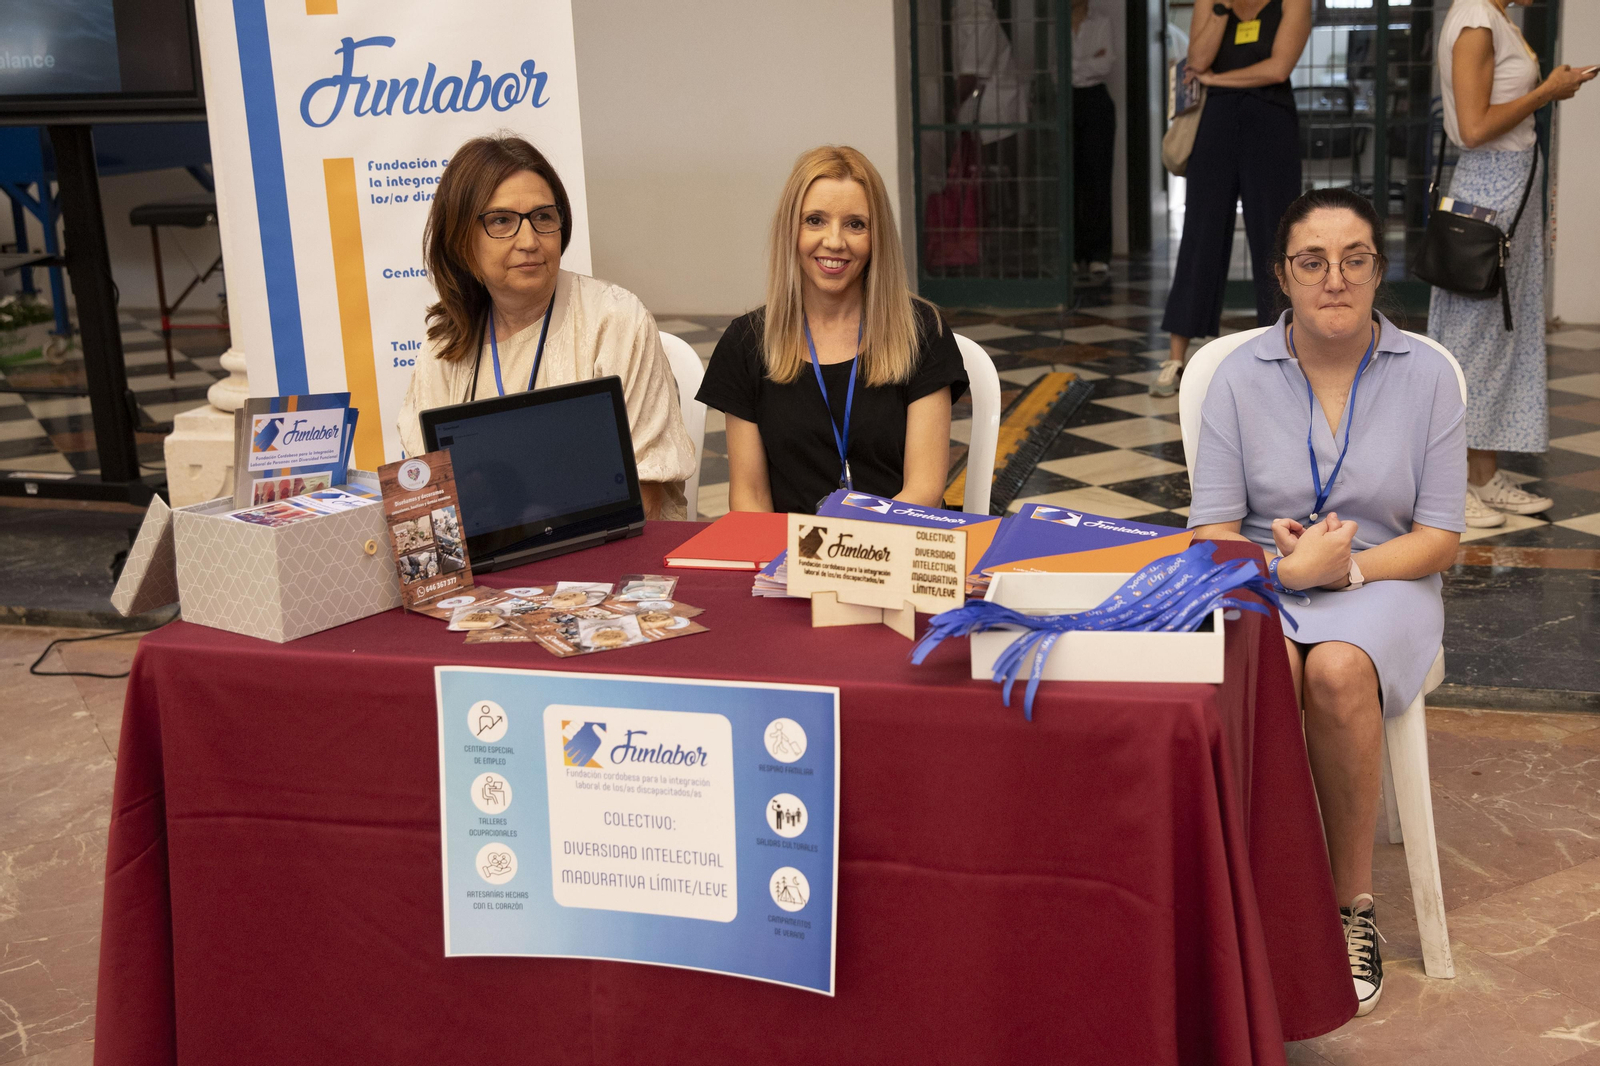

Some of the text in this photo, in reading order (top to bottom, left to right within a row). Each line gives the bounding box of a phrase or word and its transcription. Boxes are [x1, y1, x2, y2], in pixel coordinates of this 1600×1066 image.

[300, 36, 550, 128] Funlabor
[368, 158, 437, 171] Fundación
[369, 176, 441, 188] la integrac
[371, 193, 408, 205] los/as
[283, 419, 339, 446] Funlabor
[893, 507, 967, 525] Funlabor
[1083, 520, 1158, 537] Funlabor
[916, 531, 956, 544] COLECTIVO:
[827, 533, 891, 562] Funlabor
[915, 547, 956, 561] DIVERSIDAD
[798, 559, 821, 568] Fundación
[822, 563, 845, 571] cordobesa
[864, 568, 891, 577] integración
[804, 568, 820, 576] laboral
[912, 560, 958, 573] INTELECTUAL
[426, 577, 457, 593] 646 367 377
[911, 572, 958, 586] MADURATIVA
[912, 583, 956, 598] LÍMITE/LEVE
[464, 744, 514, 755] CENTRO ESPECIAL
[610, 729, 708, 767] Funlabor
[474, 757, 506, 766] DE EMPLEO
[758, 764, 814, 776] RESPIRO FAMILIAR
[566, 768, 711, 788] Fundación cordobesa para la integración
[575, 780, 702, 798] laboral de los/as discapacitados/as
[479, 817, 507, 826] TALLERES
[604, 811, 677, 831] COLECTIVO:
[469, 828, 517, 838] OCUPACIONALES
[756, 838, 818, 853] SALIDAS CULTURALES
[563, 841, 724, 868] DIVERSIDAD INTELECTUAL
[561, 869, 728, 898] MADURATIVA LÍMITE/LEVE
[467, 889, 529, 899] ARTESANÍAS HECHAS
[473, 901, 523, 911] CON EL CORAZÓN
[768, 914, 811, 929] CAMPAMENTOS
[774, 928, 805, 940] DE VERANO
